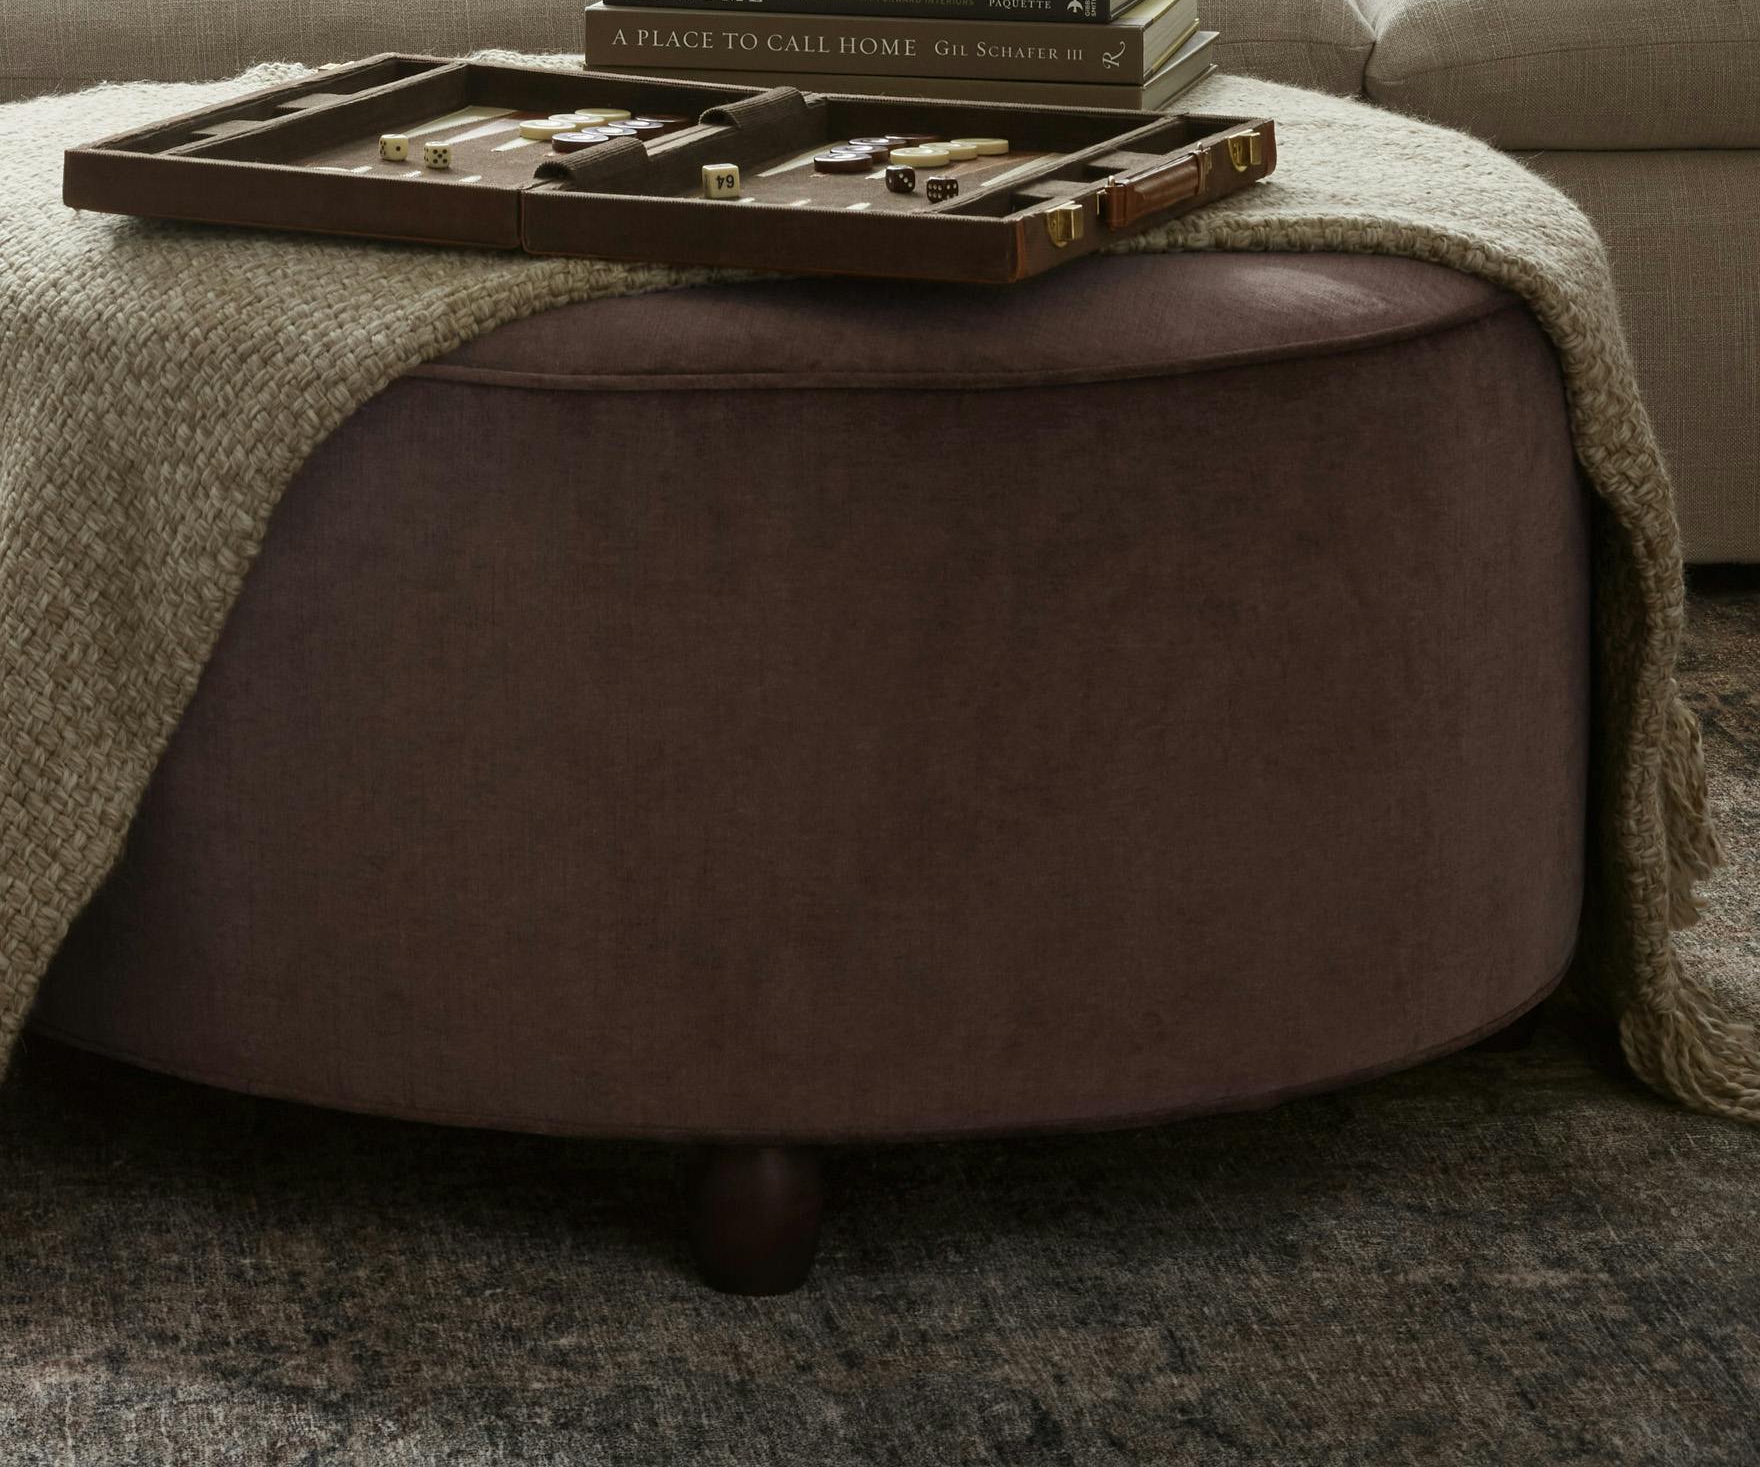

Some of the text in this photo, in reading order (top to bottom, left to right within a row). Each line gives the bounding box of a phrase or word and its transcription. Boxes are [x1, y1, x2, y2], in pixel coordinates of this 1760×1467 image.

[612, 28, 917, 56] A PLACE TO CALL HOME
[1067, 49, 1083, 60] III
[715, 174, 735, 190] 64
